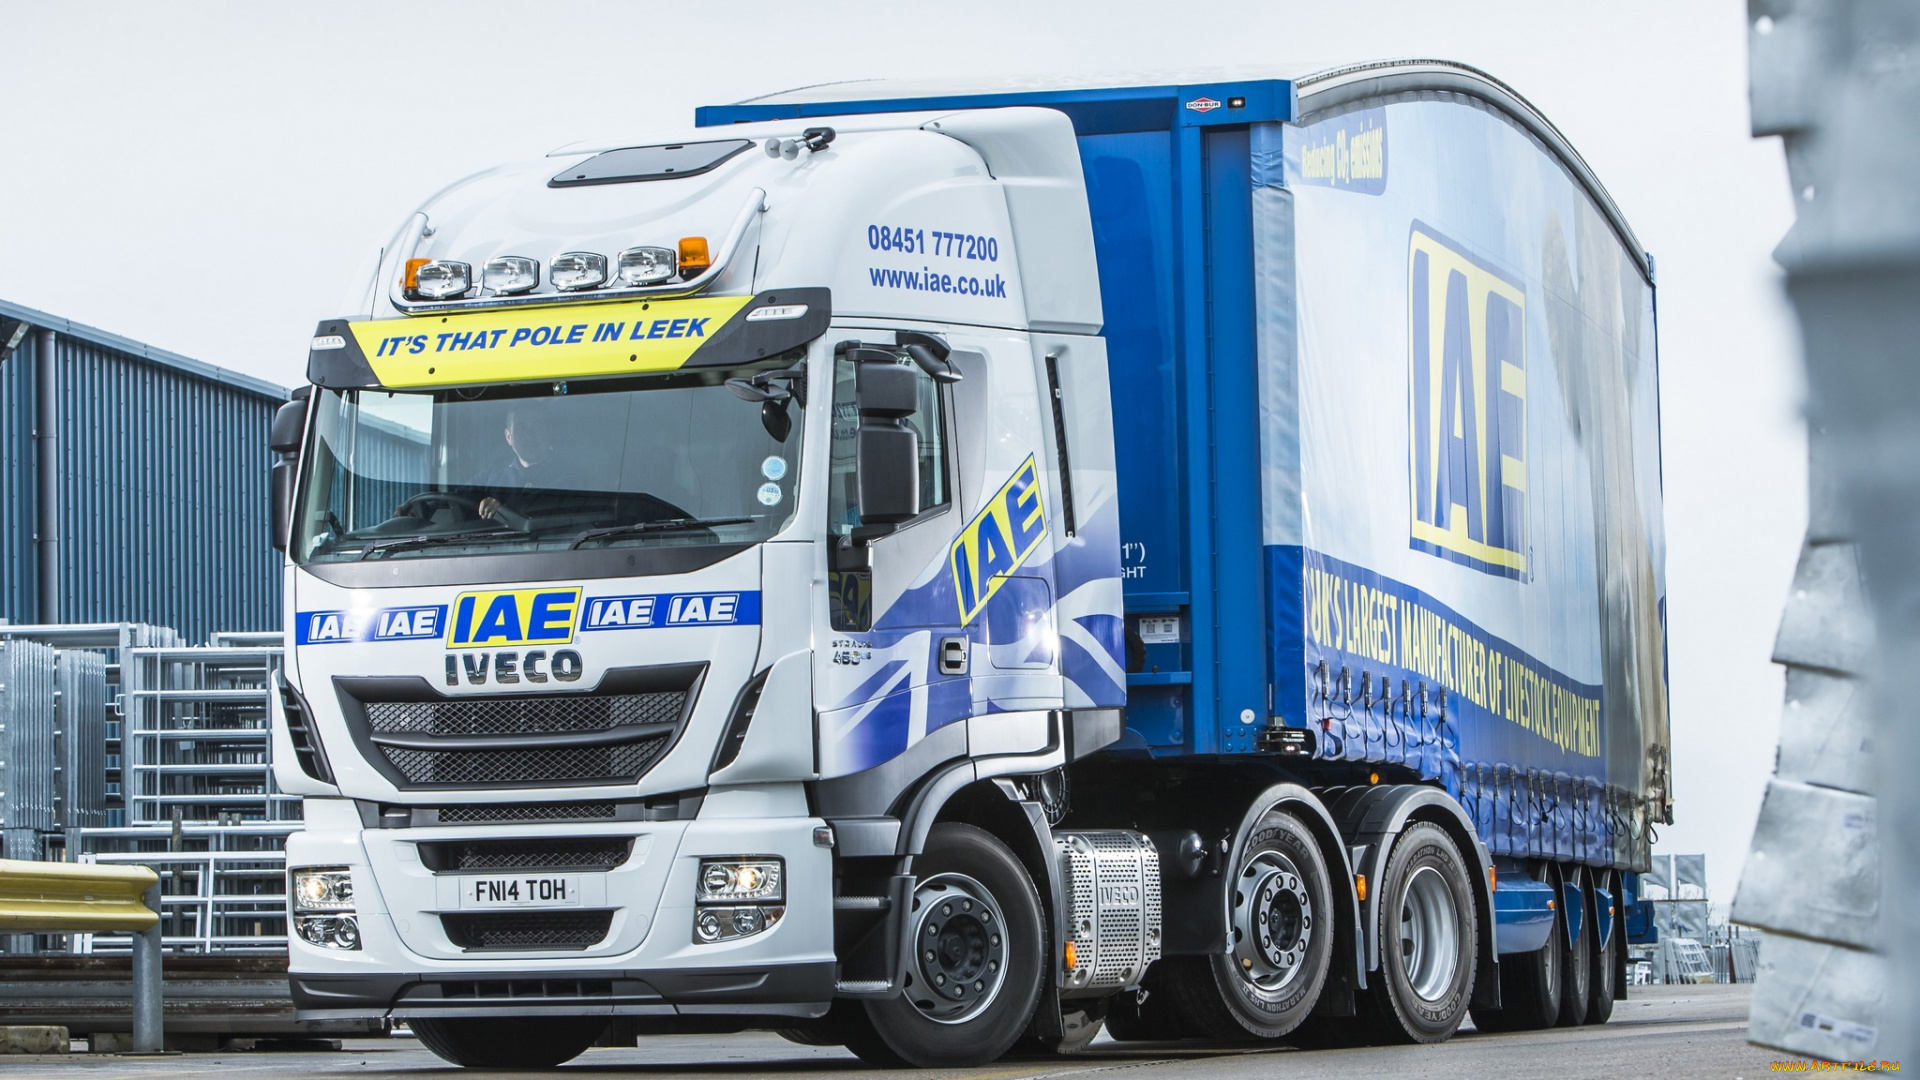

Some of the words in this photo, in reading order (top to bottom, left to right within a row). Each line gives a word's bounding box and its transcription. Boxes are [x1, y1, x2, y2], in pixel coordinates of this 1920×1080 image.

[1187, 101, 1219, 109] DON-BUR
[1350, 118, 1383, 179] emissions
[868, 224, 924, 254] 08451
[932, 230, 998, 262] 777200
[869, 266, 1006, 298] www.iae.co.uk
[376, 334, 428, 357] IT'S
[435, 328, 507, 353] THAT
[509, 323, 588, 348] POLE
[592, 321, 626, 342] IN
[629, 317, 712, 341] LEEK
[1412, 247, 1524, 557] IAE
[954, 464, 1044, 618] IAE
[310, 613, 363, 640] IAE
[378, 610, 436, 637] IAE
[453, 591, 576, 645] IAE
[590, 599, 653, 626] IAE
[669, 596, 736, 623] IAE
[445, 648, 583, 686] IVECO
[1344, 579, 1397, 667] LARGEST
[1401, 599, 1488, 710] MANUFACTURER
[1488, 648, 1502, 716] OF
[1504, 655, 1551, 742] LIVESTOCK
[1552, 683, 1600, 757] EQUIPMENT
[475, 880, 520, 902] FN14
[526, 878, 566, 900] TOH
[1099, 886, 1139, 905] IVECO
[1266, 985, 1306, 1013] MARATHON
